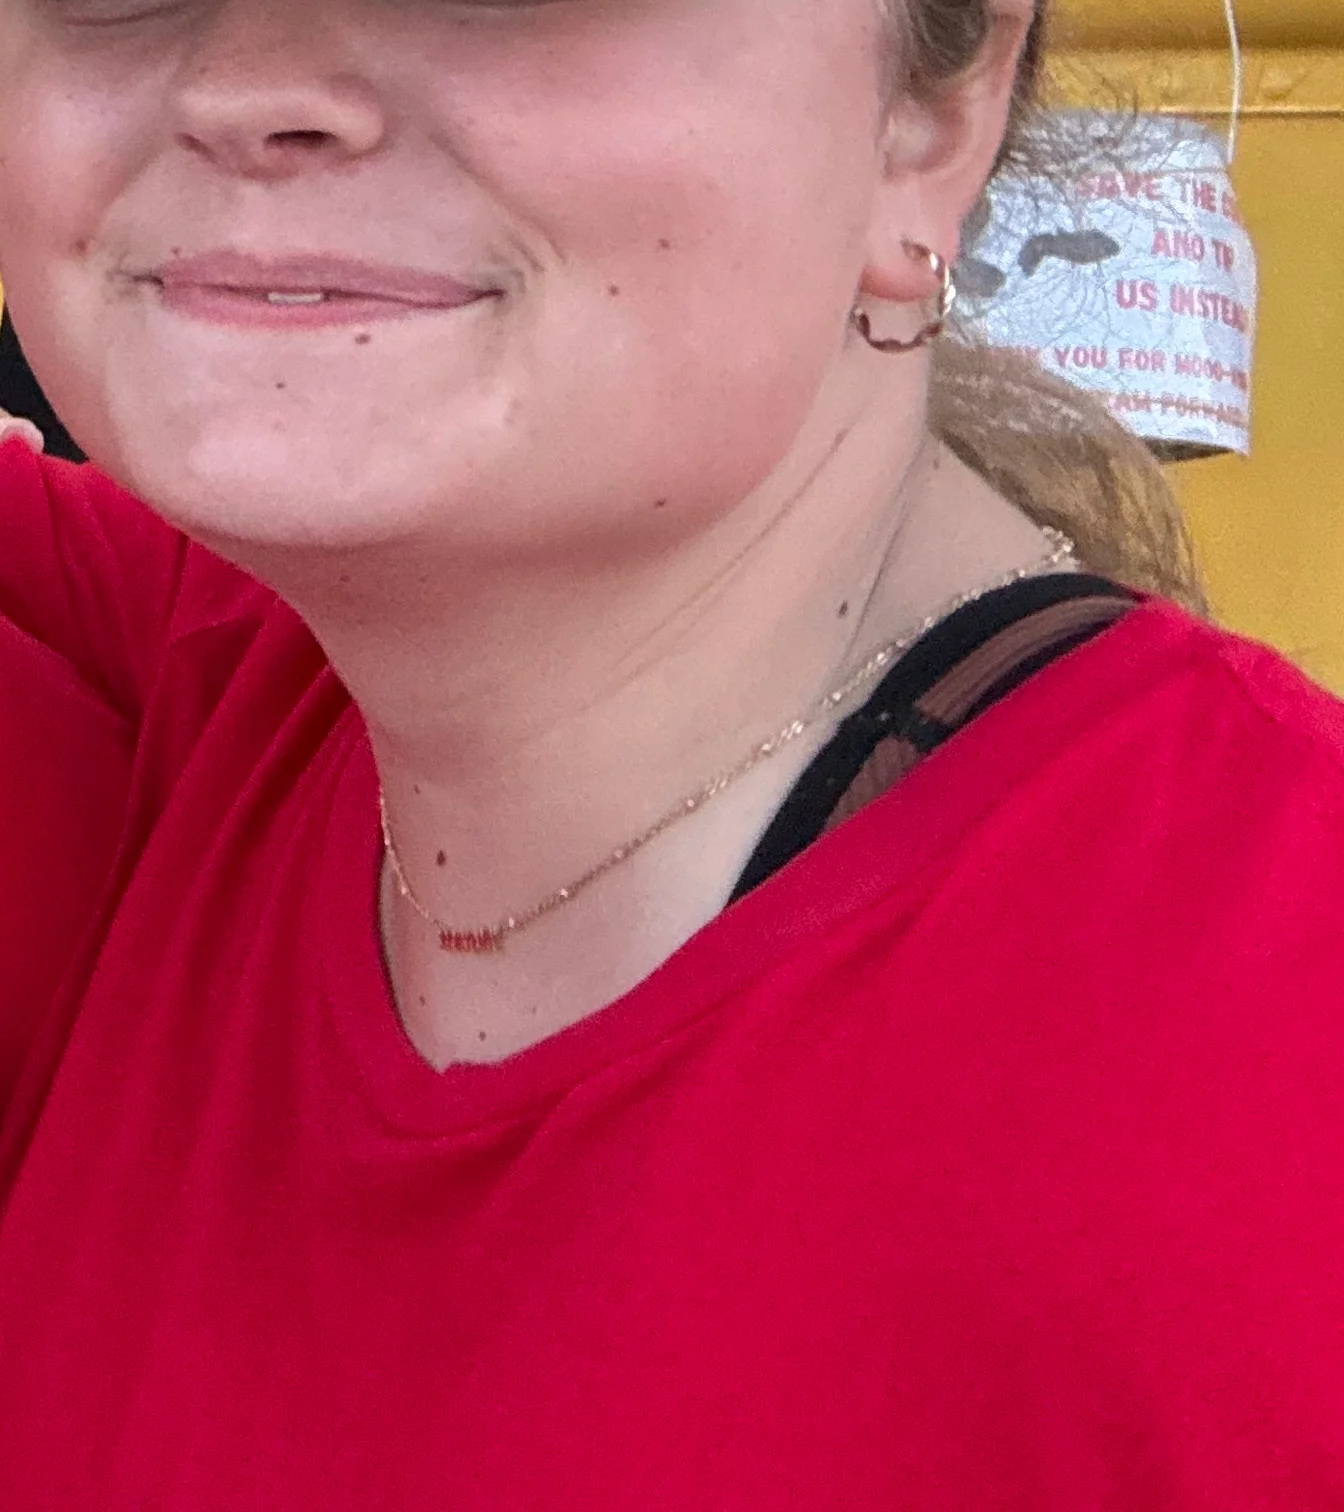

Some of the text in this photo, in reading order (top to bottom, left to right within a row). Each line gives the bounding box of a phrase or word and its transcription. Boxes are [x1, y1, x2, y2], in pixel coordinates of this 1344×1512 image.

[1150, 227, 1206, 262] AND
[1115, 278, 1158, 313] US
[1054, 345, 1109, 369] YOU
[1117, 346, 1166, 372] FOR
